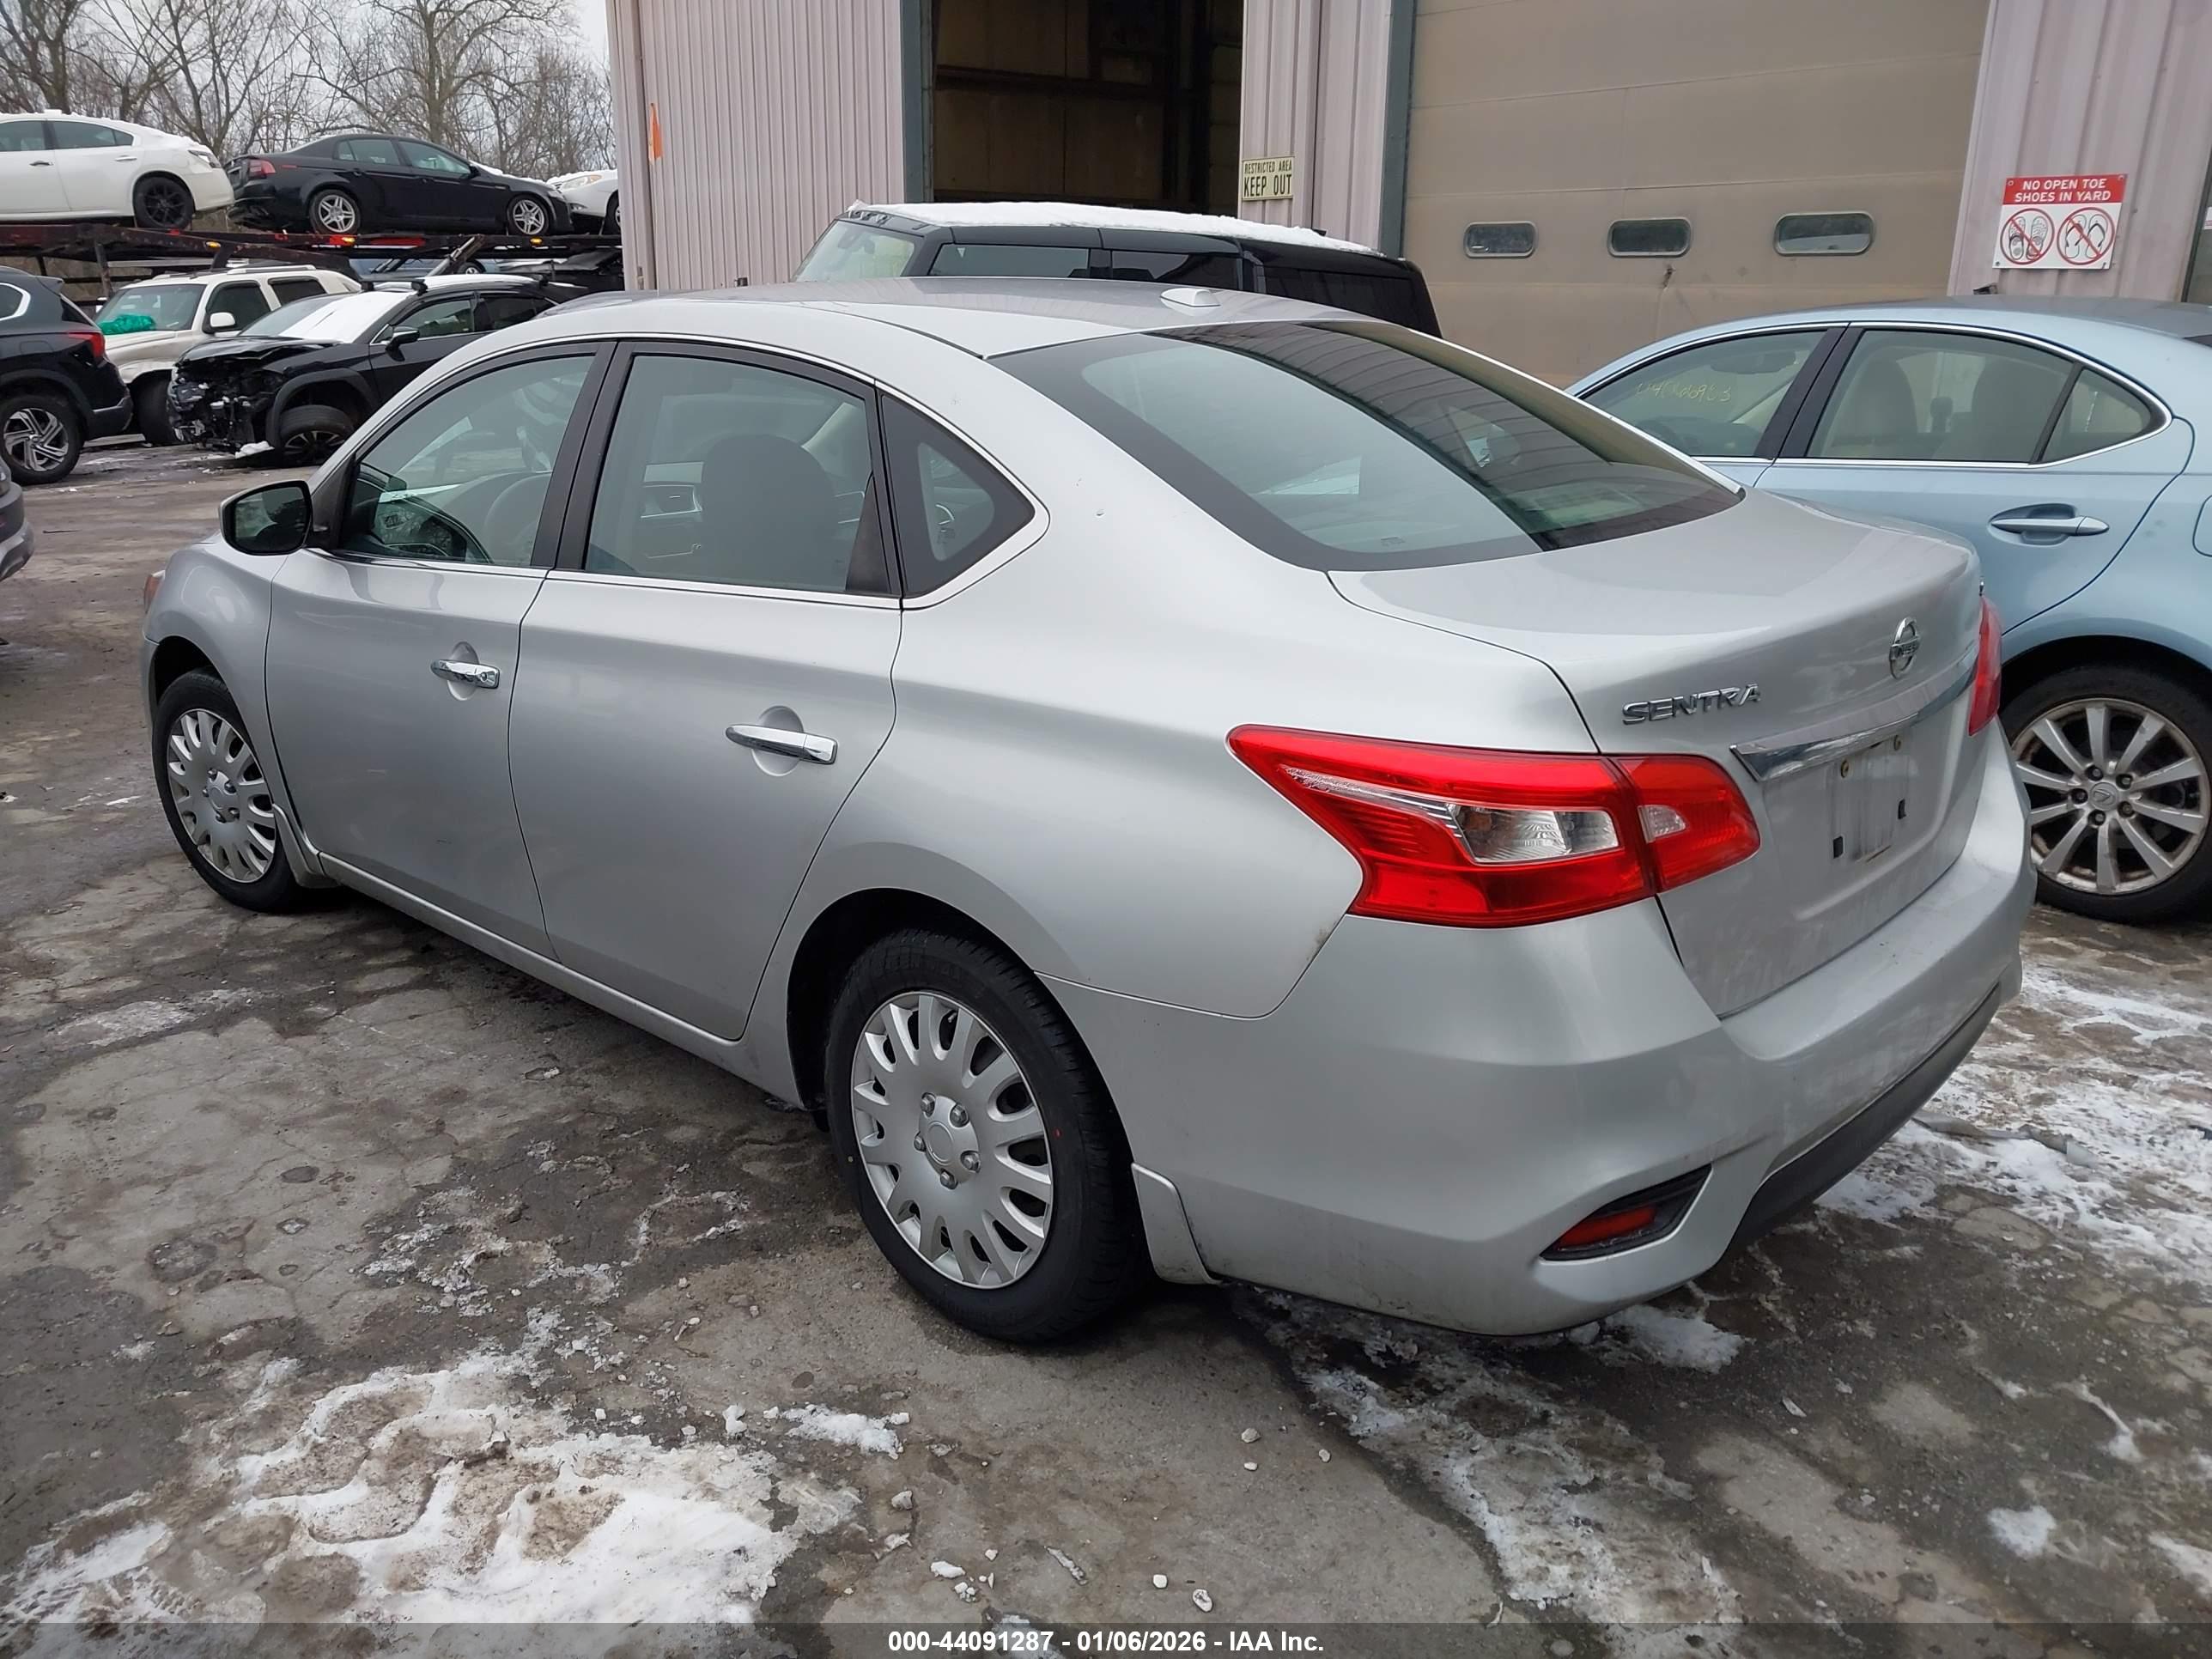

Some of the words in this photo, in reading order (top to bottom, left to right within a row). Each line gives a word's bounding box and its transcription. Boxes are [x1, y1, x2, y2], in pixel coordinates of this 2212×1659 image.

[1244, 162, 1275, 173] RESTRICTED
[1279, 160, 1291, 172] AREA
[1243, 177, 1267, 197] KEEP
[1273, 174, 1291, 195] OUT
[2023, 180, 2040, 190] NO
[2044, 179, 2078, 190] OPEN
[2082, 179, 2106, 188] TOE
[2014, 191, 2056, 203] SHOES
[2059, 191, 2073, 202] IN
[2077, 191, 2111, 201] YARD
[1622, 683, 1760, 726] SENTRA
